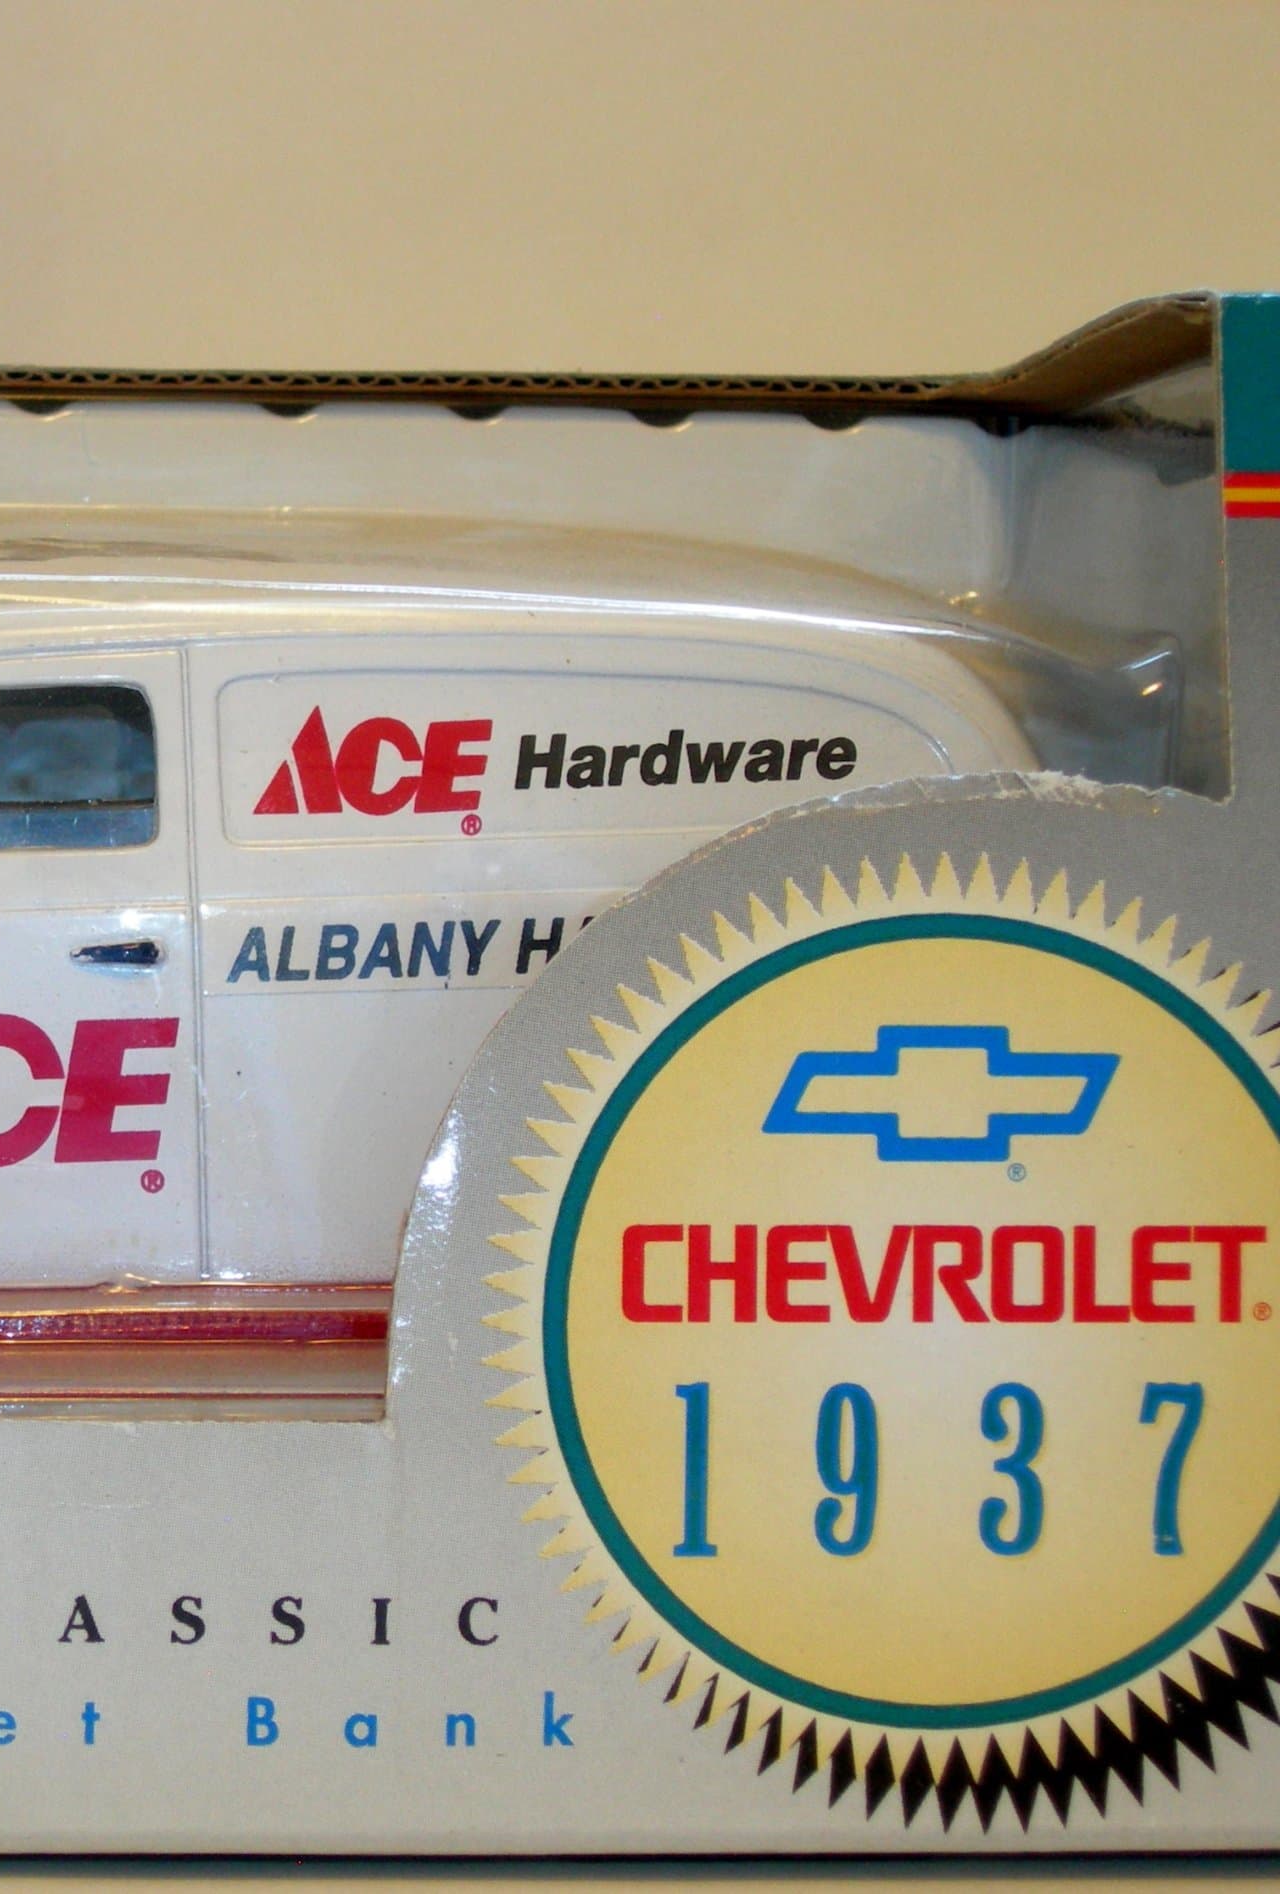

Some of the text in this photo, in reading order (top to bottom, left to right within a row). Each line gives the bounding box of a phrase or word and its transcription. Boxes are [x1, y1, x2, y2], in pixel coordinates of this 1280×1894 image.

[252, 705, 857, 816] ACE Hardware
[226, 916, 594, 983] ALBANY H
[621, 1224, 1267, 1323] CHEVROLET
[673, 1382, 1205, 1557] 1937
[245, 1692, 575, 1748] Bank
